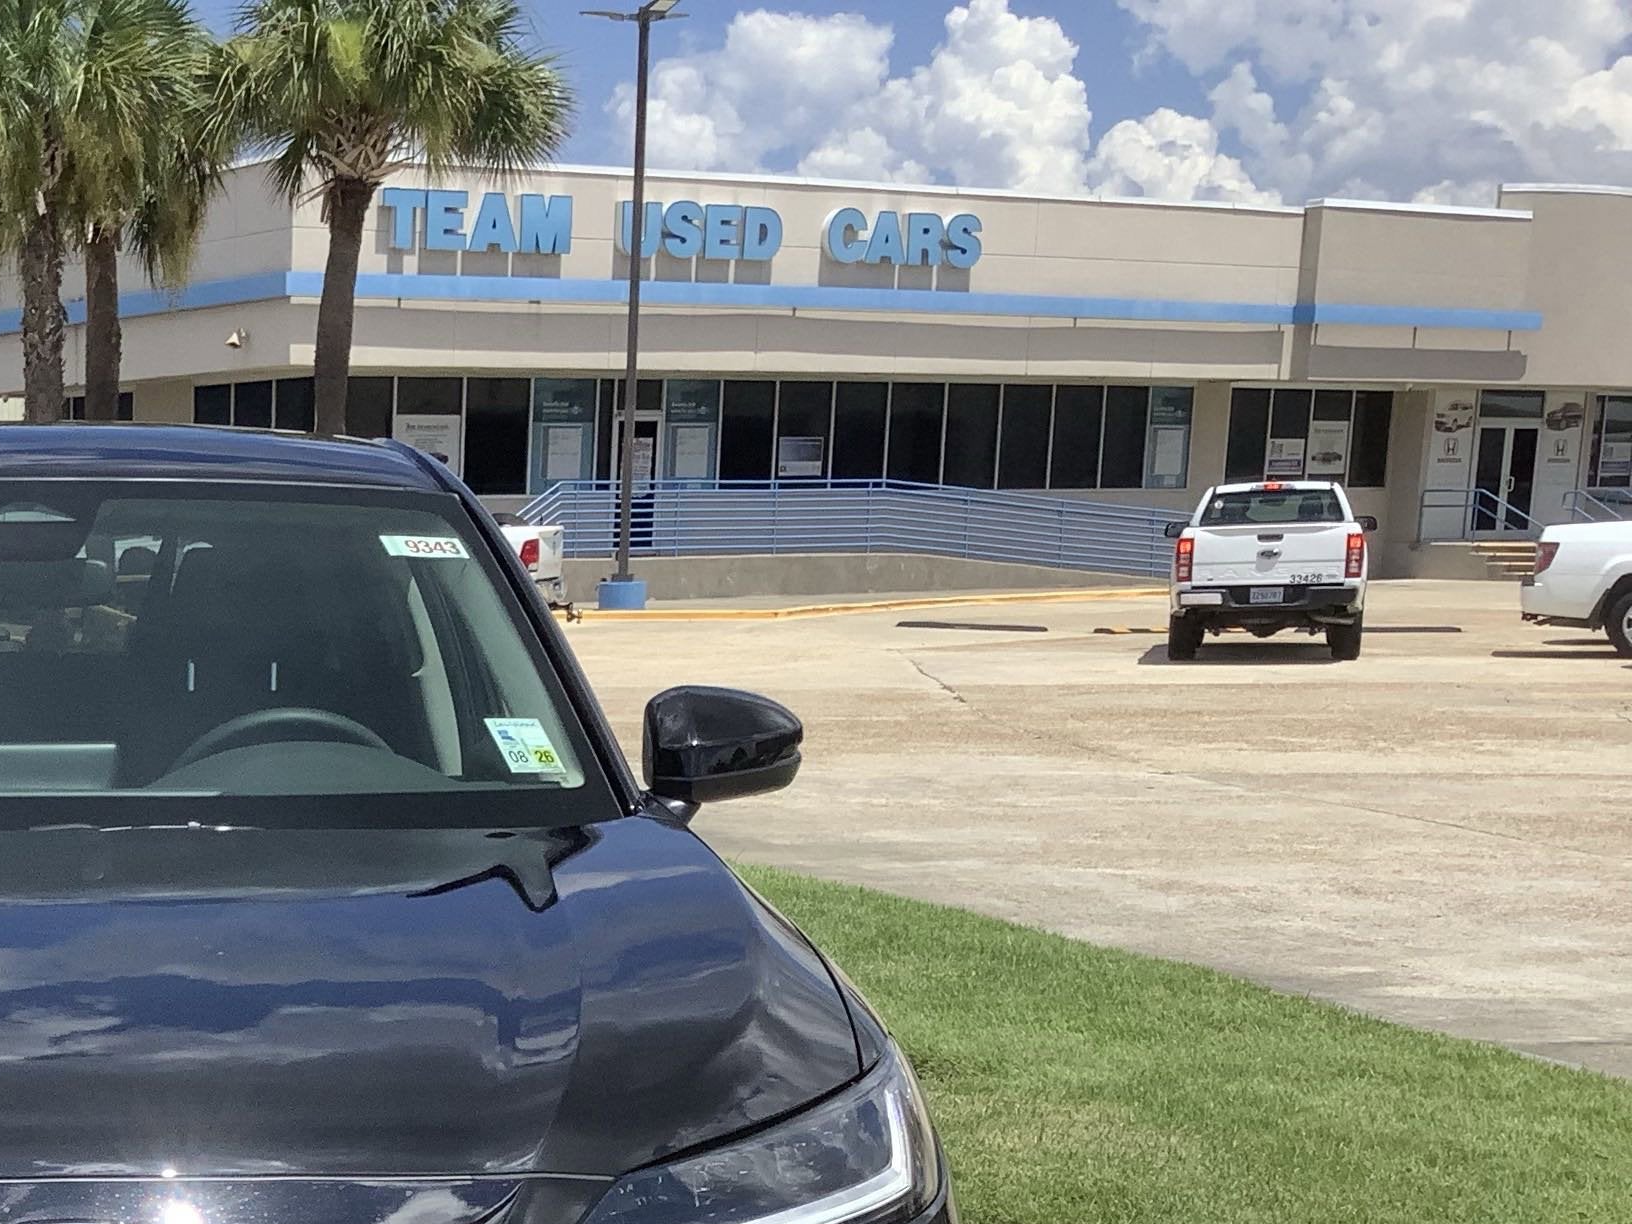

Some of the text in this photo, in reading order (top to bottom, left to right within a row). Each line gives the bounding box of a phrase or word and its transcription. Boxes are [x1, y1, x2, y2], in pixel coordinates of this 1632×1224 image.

[383, 187, 982, 269] TEAM USED CARS
[404, 539, 461, 555] 9343
[1289, 573, 1323, 584] 33426
[508, 750, 554, 763] 08 26
